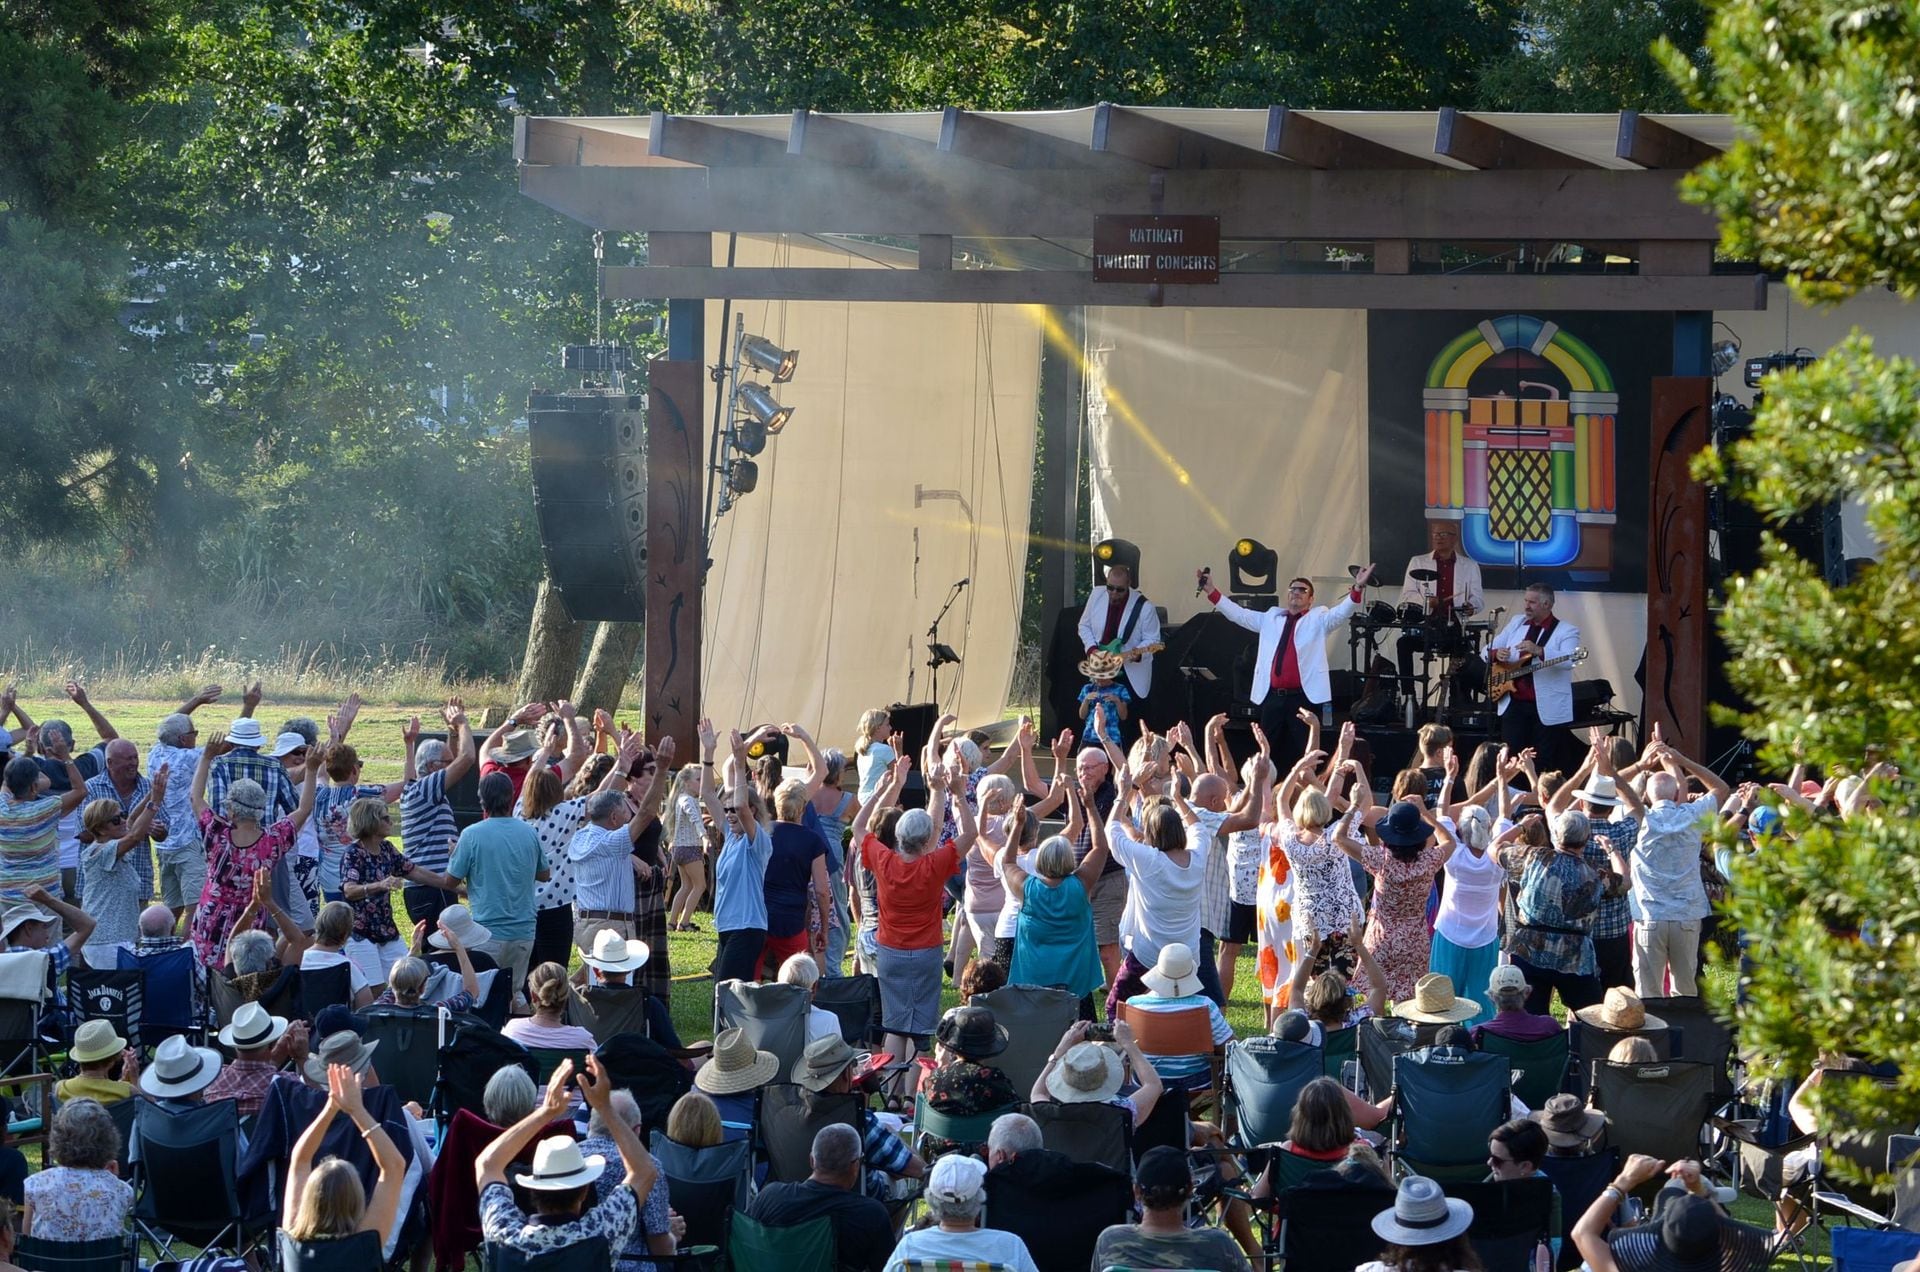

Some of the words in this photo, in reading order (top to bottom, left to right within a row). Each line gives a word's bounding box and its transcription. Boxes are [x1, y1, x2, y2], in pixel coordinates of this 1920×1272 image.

[1129, 228, 1184, 243] KATIKATI
[1096, 254, 1151, 270] TWILIGHT
[1156, 255, 1217, 270] CONCERTS
[87, 987, 101, 1000] JACK
